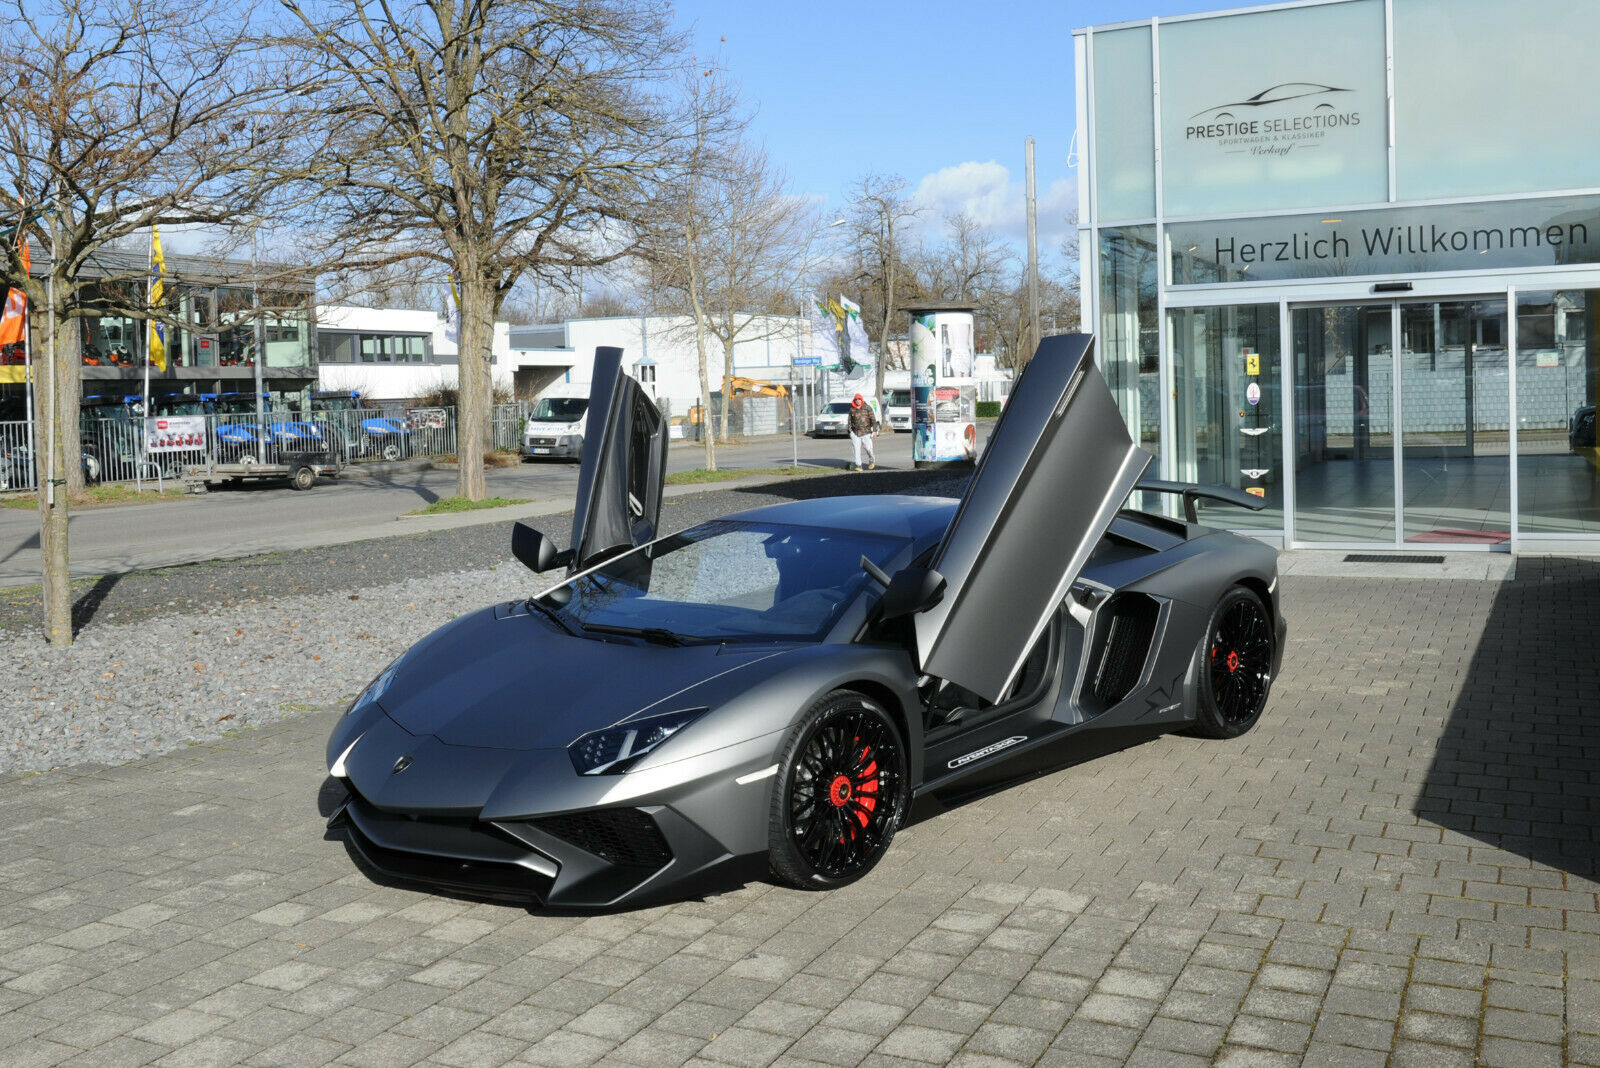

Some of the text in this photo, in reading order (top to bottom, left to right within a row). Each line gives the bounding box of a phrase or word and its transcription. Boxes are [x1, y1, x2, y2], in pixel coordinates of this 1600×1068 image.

[1186, 112, 1361, 139] PRESTIGE SELECTIONS
[1218, 135, 1271, 146] SPORTWAGEN
[1281, 130, 1326, 141] KLASSIKER
[1215, 223, 1588, 265] Herzlich Willkommen
